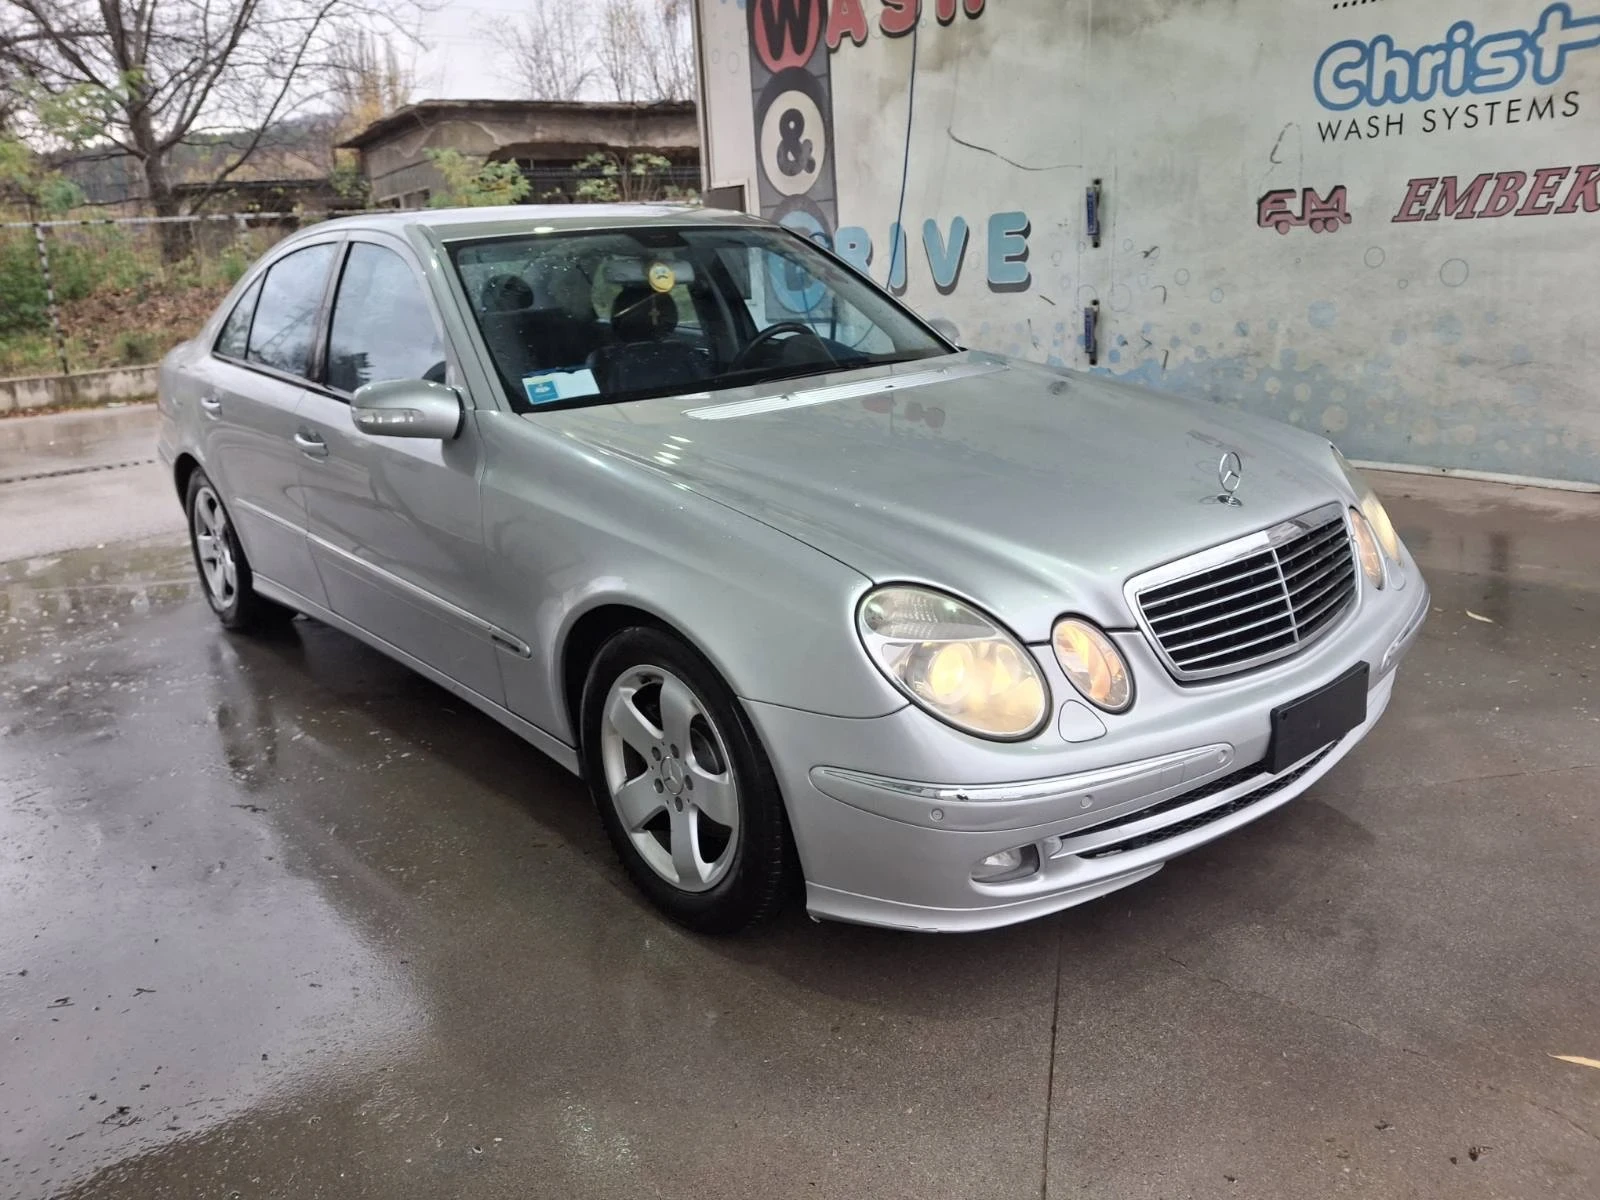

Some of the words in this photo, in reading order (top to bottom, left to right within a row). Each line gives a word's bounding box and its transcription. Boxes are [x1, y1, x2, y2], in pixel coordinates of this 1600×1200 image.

[756, 0, 985, 61] WAS
[1313, 2, 1600, 111] Christ
[776, 108, 816, 177] &
[1317, 112, 1404, 143] WASH
[1422, 91, 1580, 133] SYSTEMS
[1391, 164, 1600, 223] EMBEK
